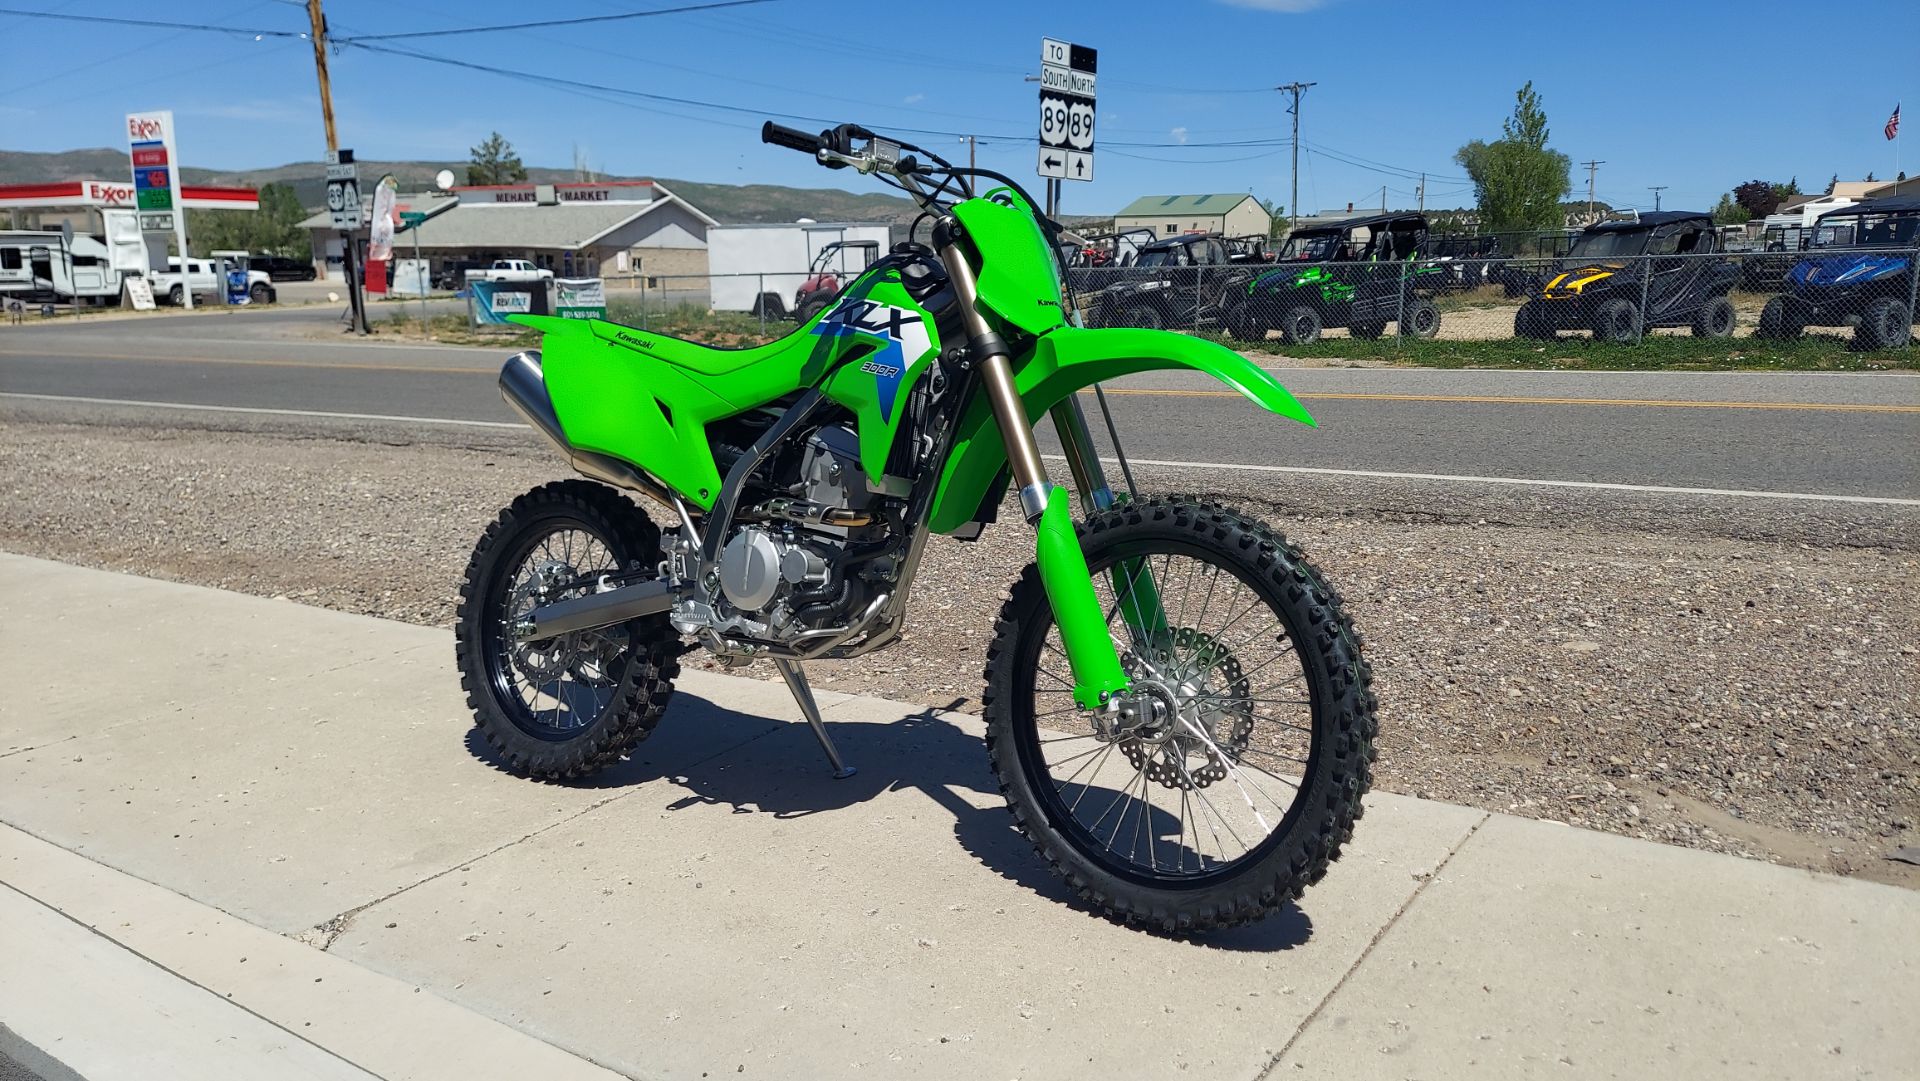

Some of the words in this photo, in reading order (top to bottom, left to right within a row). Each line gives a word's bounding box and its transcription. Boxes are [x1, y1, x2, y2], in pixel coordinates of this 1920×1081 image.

[1050, 44, 1063, 60] TO
[1043, 68, 1068, 88] SOUTH
[1071, 74, 1095, 94] NORTH
[130, 118, 162, 140] Exxon
[1043, 106, 1066, 133] 89
[1071, 112, 1092, 138] 89
[564, 190, 609, 201] MARKET
[615, 330, 656, 350] Kawasaki
[860, 361, 900, 379] 300R
